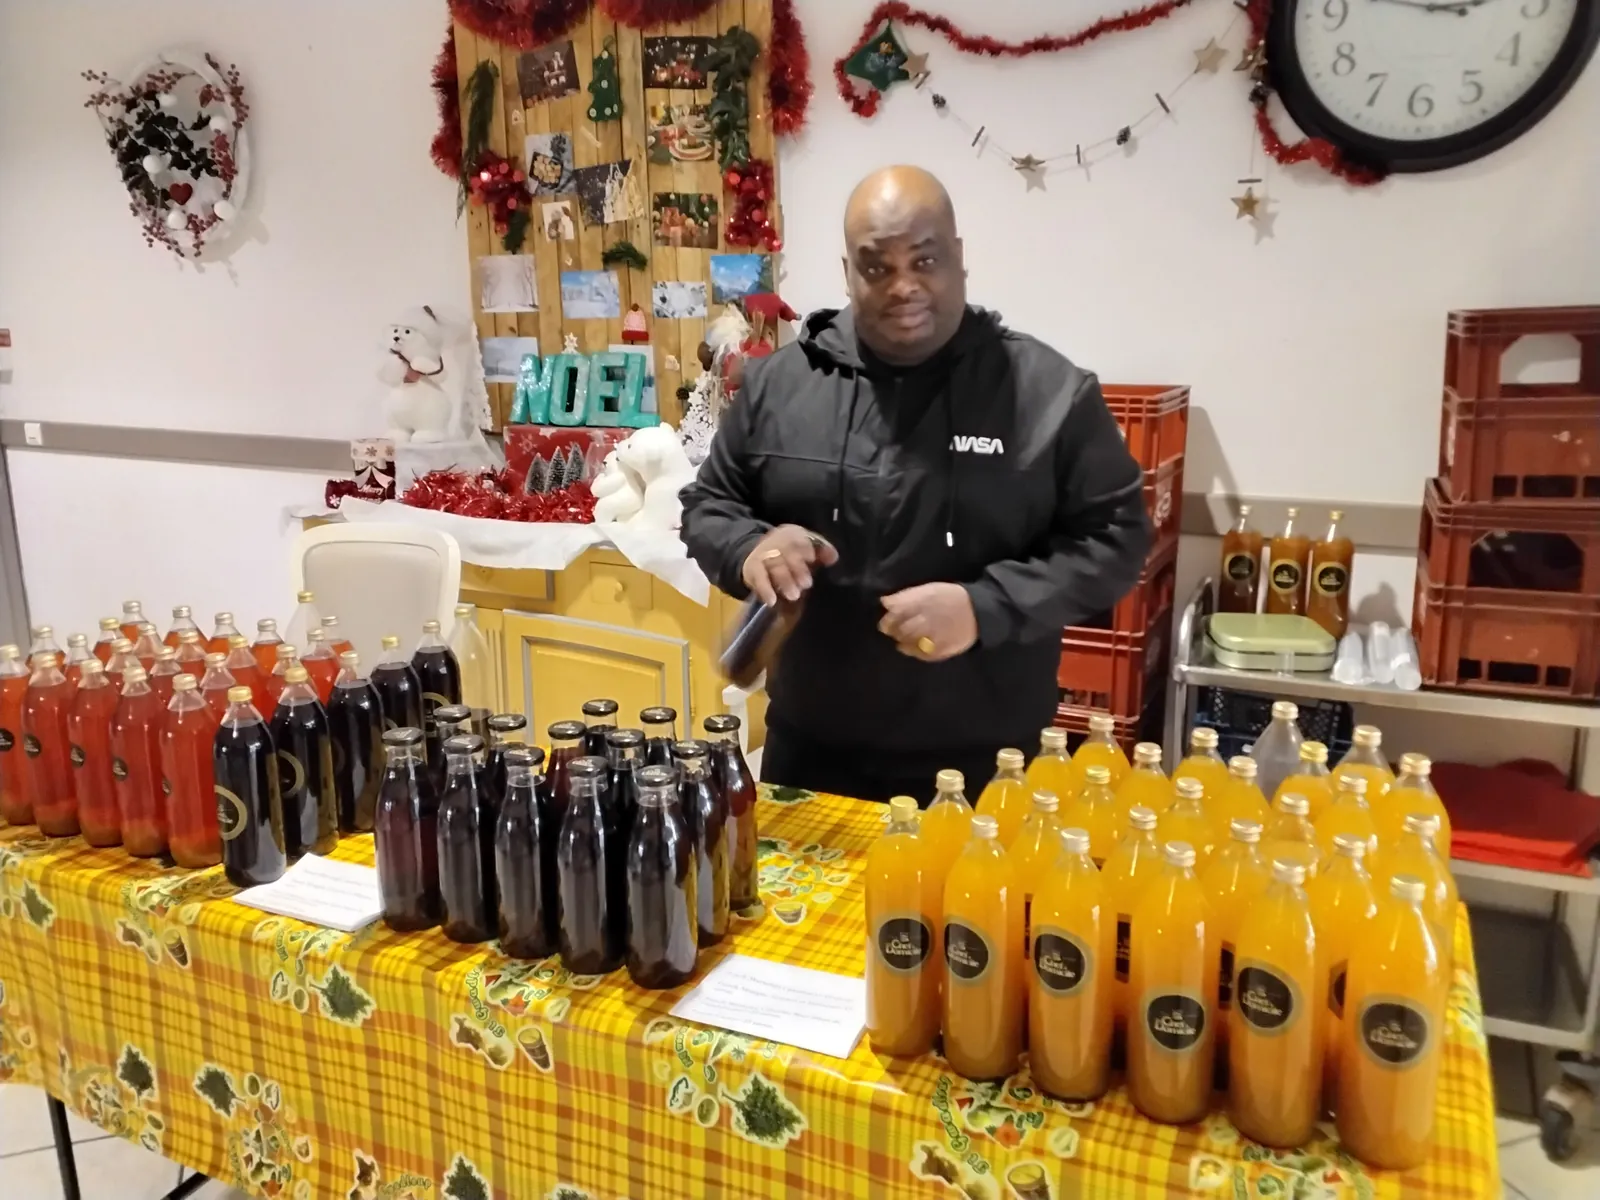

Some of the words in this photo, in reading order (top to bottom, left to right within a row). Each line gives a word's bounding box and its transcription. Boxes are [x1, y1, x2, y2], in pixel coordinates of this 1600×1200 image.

[1331, 41, 1356, 76] 8
[1494, 31, 1522, 67] 4
[1365, 72, 1389, 107] 7
[1407, 83, 1435, 118] 6
[1458, 69, 1485, 105] 5
[509, 352, 660, 427] NOEL
[948, 434, 1005, 455] NASA
